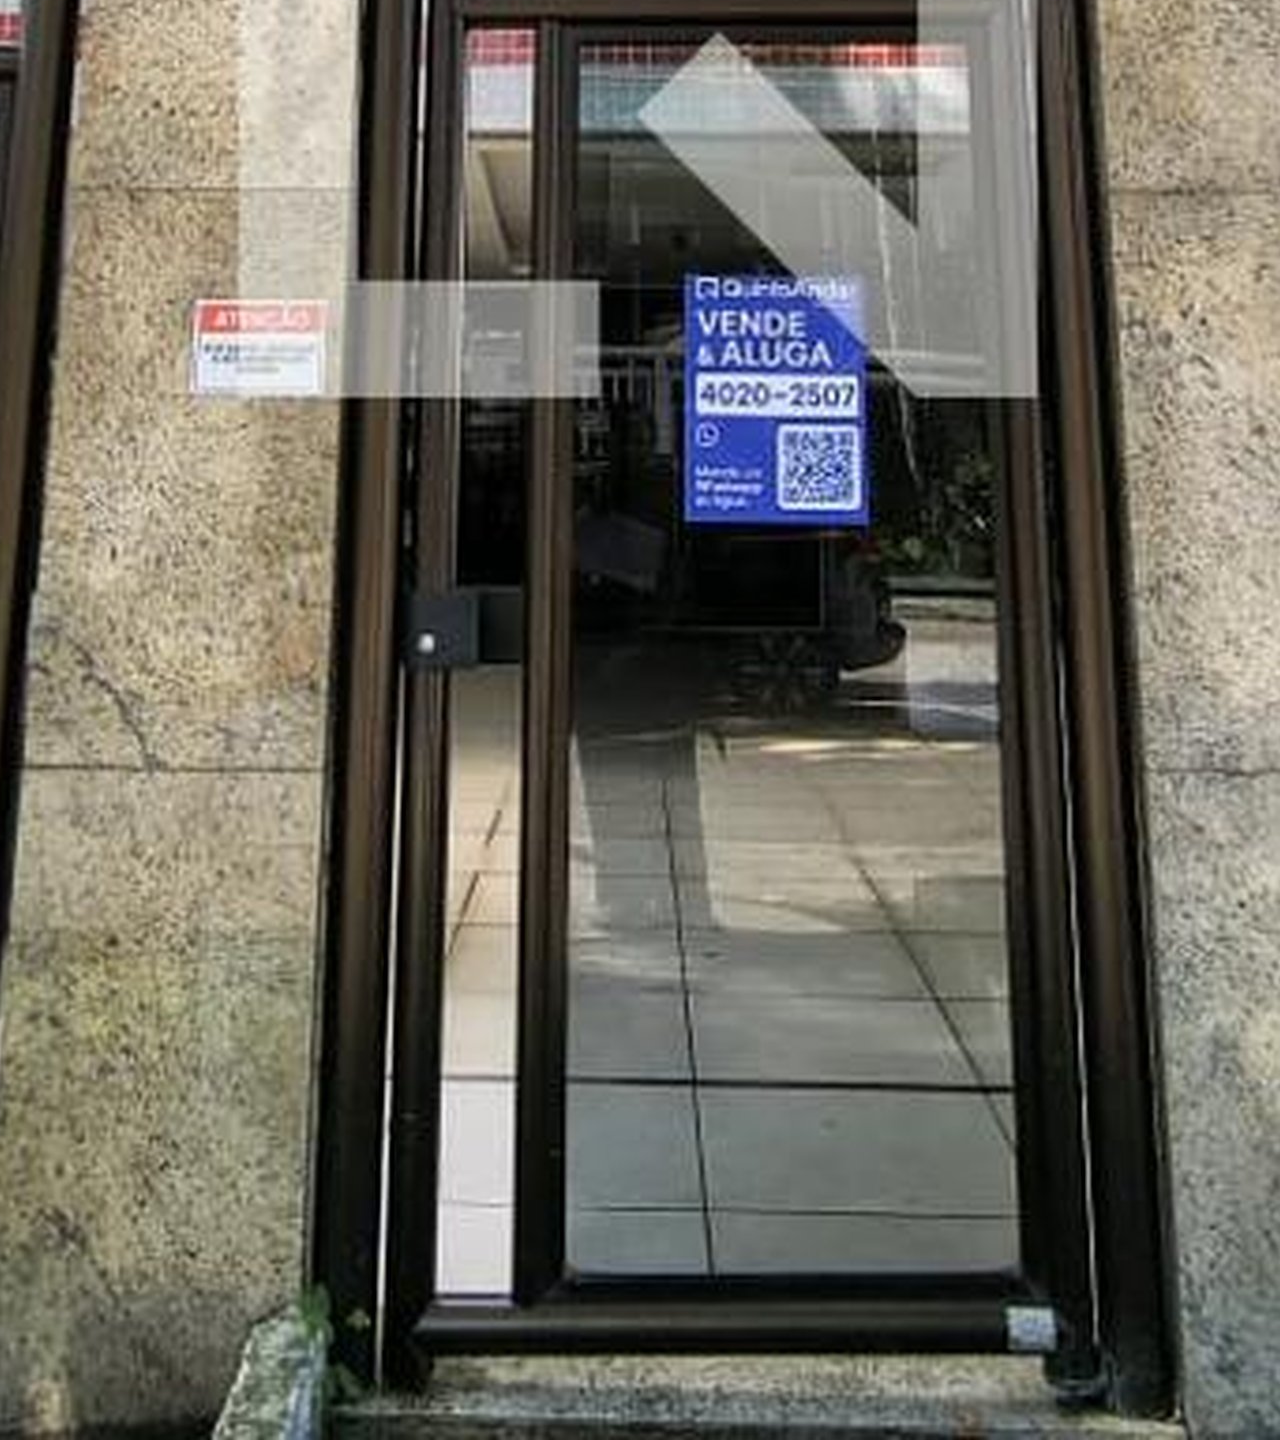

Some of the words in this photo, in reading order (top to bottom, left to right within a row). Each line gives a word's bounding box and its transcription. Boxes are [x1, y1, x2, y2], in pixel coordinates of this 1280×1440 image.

[698, 310, 807, 338] VENDE
[720, 340, 834, 369] ALUGA
[699, 381, 856, 407] 4020-2507
